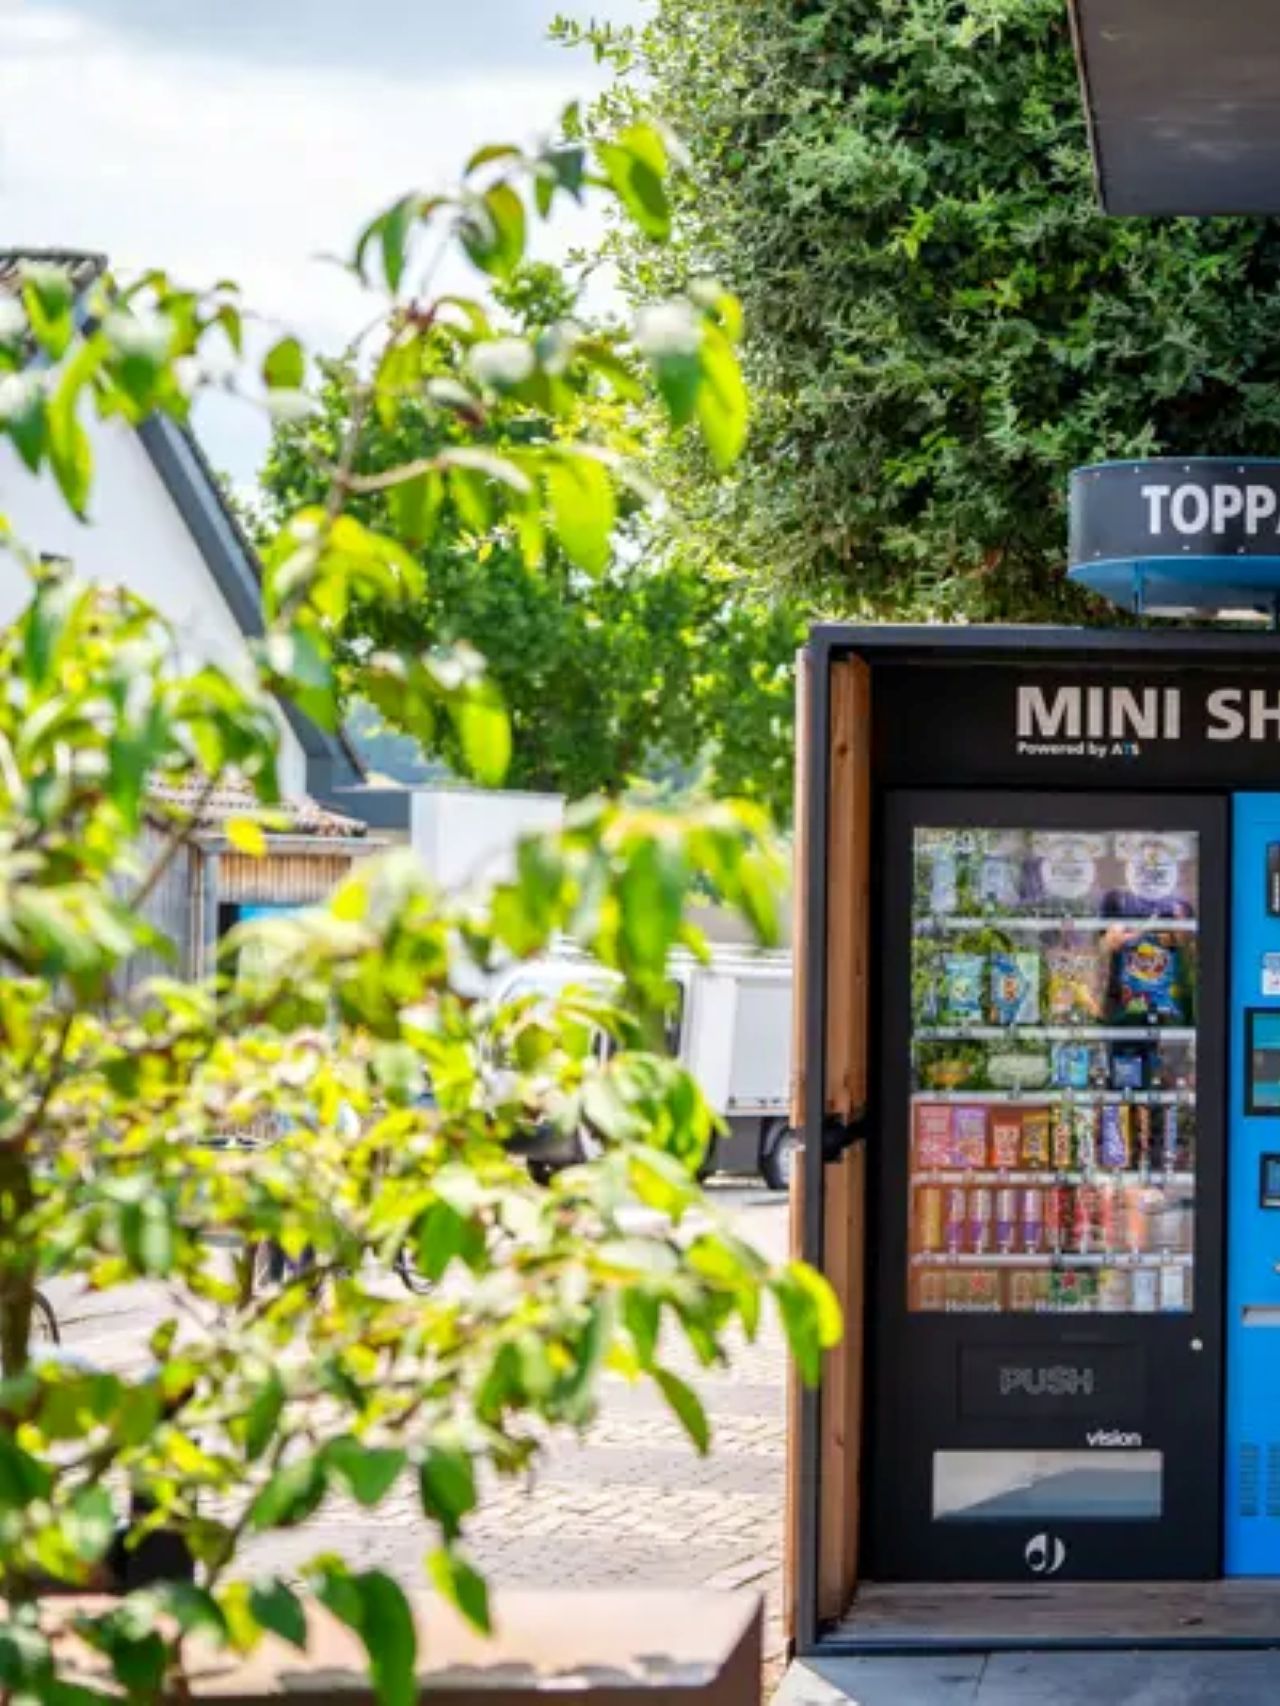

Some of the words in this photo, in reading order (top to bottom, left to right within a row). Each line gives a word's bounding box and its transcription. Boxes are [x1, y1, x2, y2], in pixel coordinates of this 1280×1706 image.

[1017, 686, 1180, 740] MINI
[1017, 741, 1084, 755] Powered
[1089, 741, 1107, 758] by
[1000, 1367, 1094, 1396] PUSH
[1086, 1429, 1142, 1446] vision
